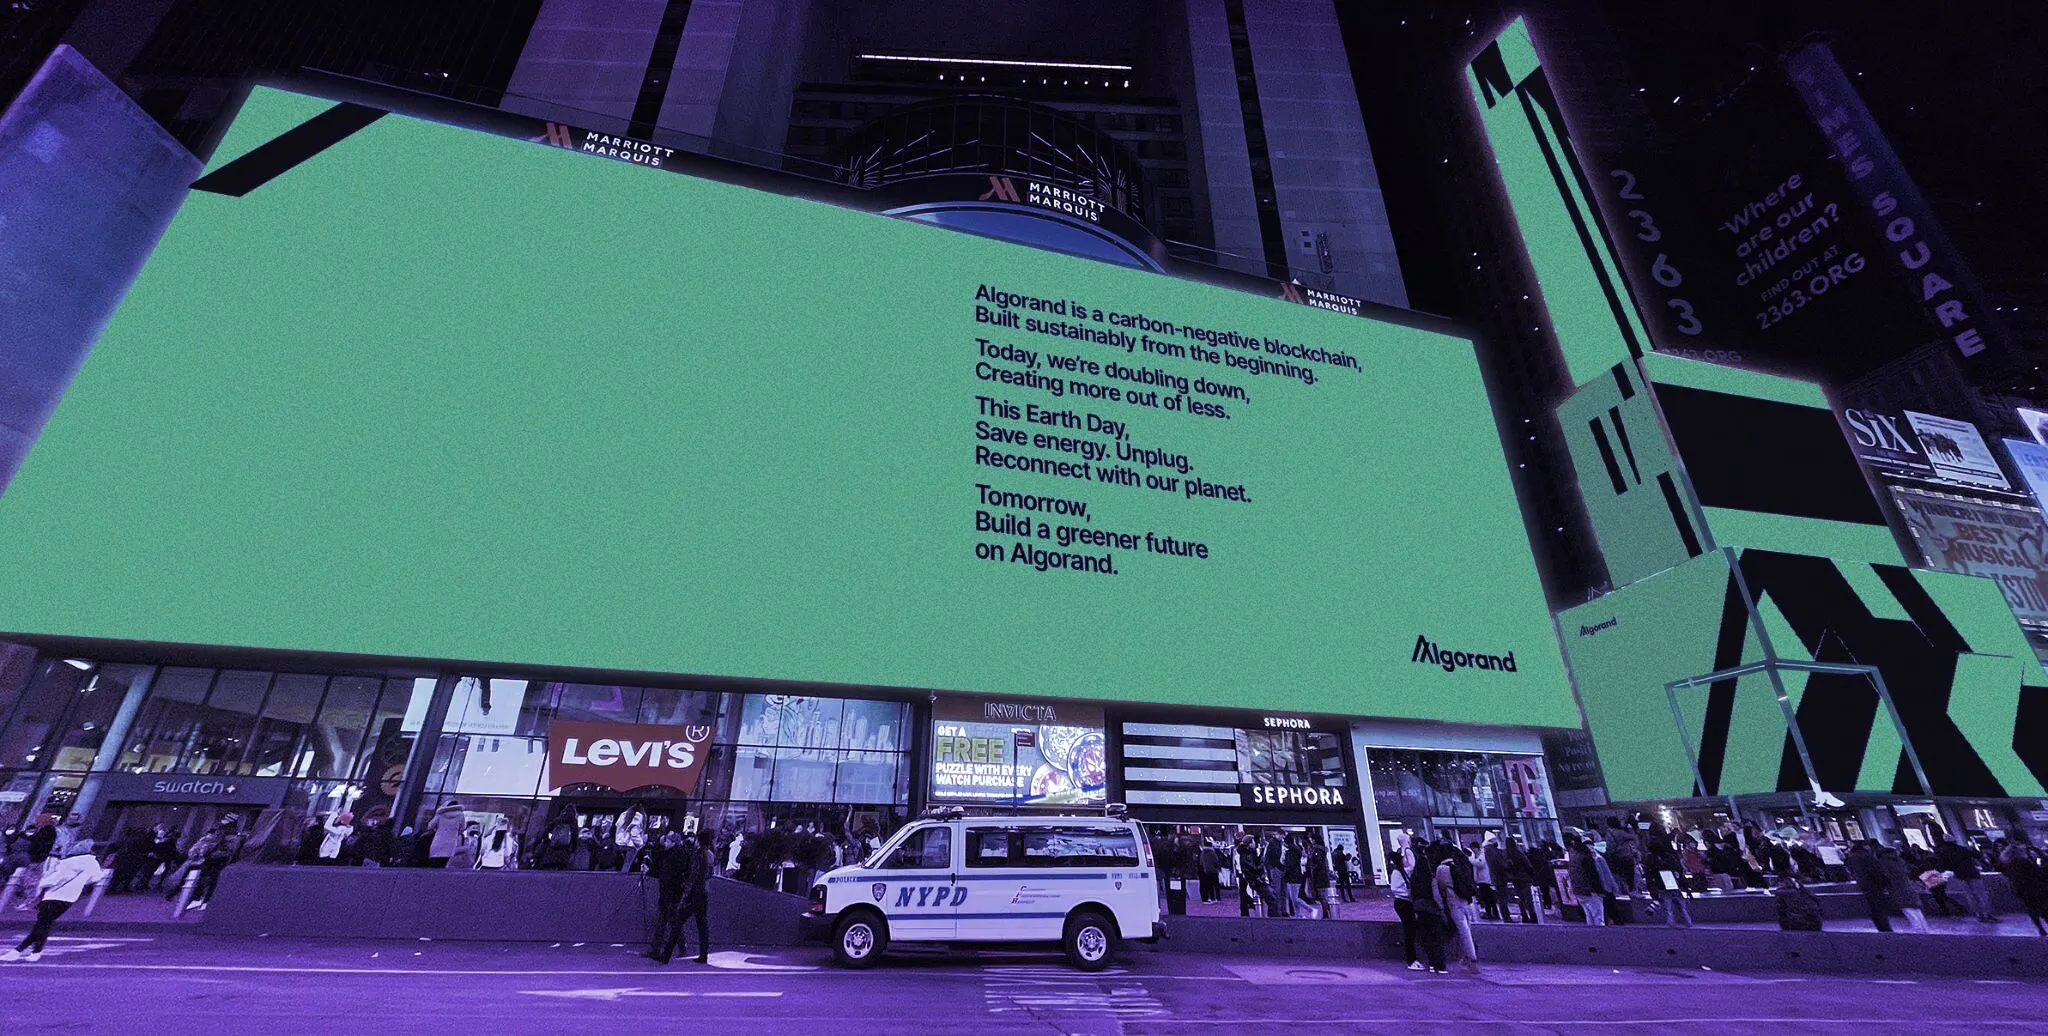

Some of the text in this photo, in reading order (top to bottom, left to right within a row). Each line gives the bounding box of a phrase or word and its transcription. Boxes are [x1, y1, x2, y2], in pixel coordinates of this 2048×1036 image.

[583, 142, 660, 166] MARQUIS
[586, 131, 674, 158] MARRIOTT
[1029, 182, 1105, 213] MARRIOTT
[1029, 194, 1098, 221] MARQUIS
[1723, 174, 1804, 235] Where
[1736, 192, 1815, 258] are our
[1736, 202, 1840, 287] children?
[1760, 277, 1790, 303] FIND
[1792, 256, 1820, 281] OUT
[1872, 191, 1987, 358] SQUARE
[1307, 289, 1361, 307] MARRIOTT
[1309, 299, 1357, 315] MARQUIS
[1756, 252, 1866, 331] 2363.ORG
[975, 284, 1361, 372] Algorand is a carbon-negative blockchain,
[976, 305, 1318, 385] Built sustainably from the beginning.
[975, 338, 1041, 369] Today,
[1105, 362, 1189, 394] doubling
[1194, 377, 1250, 404] down,
[976, 362, 1230, 419] Creating more out of less.
[975, 396, 1129, 441] This Earth Day,
[976, 421, 1193, 474] Save energy. Unplug.
[976, 445, 1251, 502] Reconnect with our planet.
[975, 484, 1090, 522] Tomorrow,
[976, 510, 1208, 559] Build a greener future
[976, 542, 1118, 575] on Algorand.
[1580, 616, 1617, 637] Algorand
[1411, 634, 1517, 673] Algorand
[984, 702, 1056, 721] INVICTA
[1263, 717, 1311, 729] SEPHORA
[937, 725, 966, 737] GET A
[936, 736, 1004, 764] FREE
[935, 762, 1032, 777] PUZZLE WITH EVERY
[935, 773, 971, 786] WATCH
[153, 780, 224, 794] swatch
[1253, 786, 1344, 805] SEPHORA
[895, 886, 968, 907] NYPD
